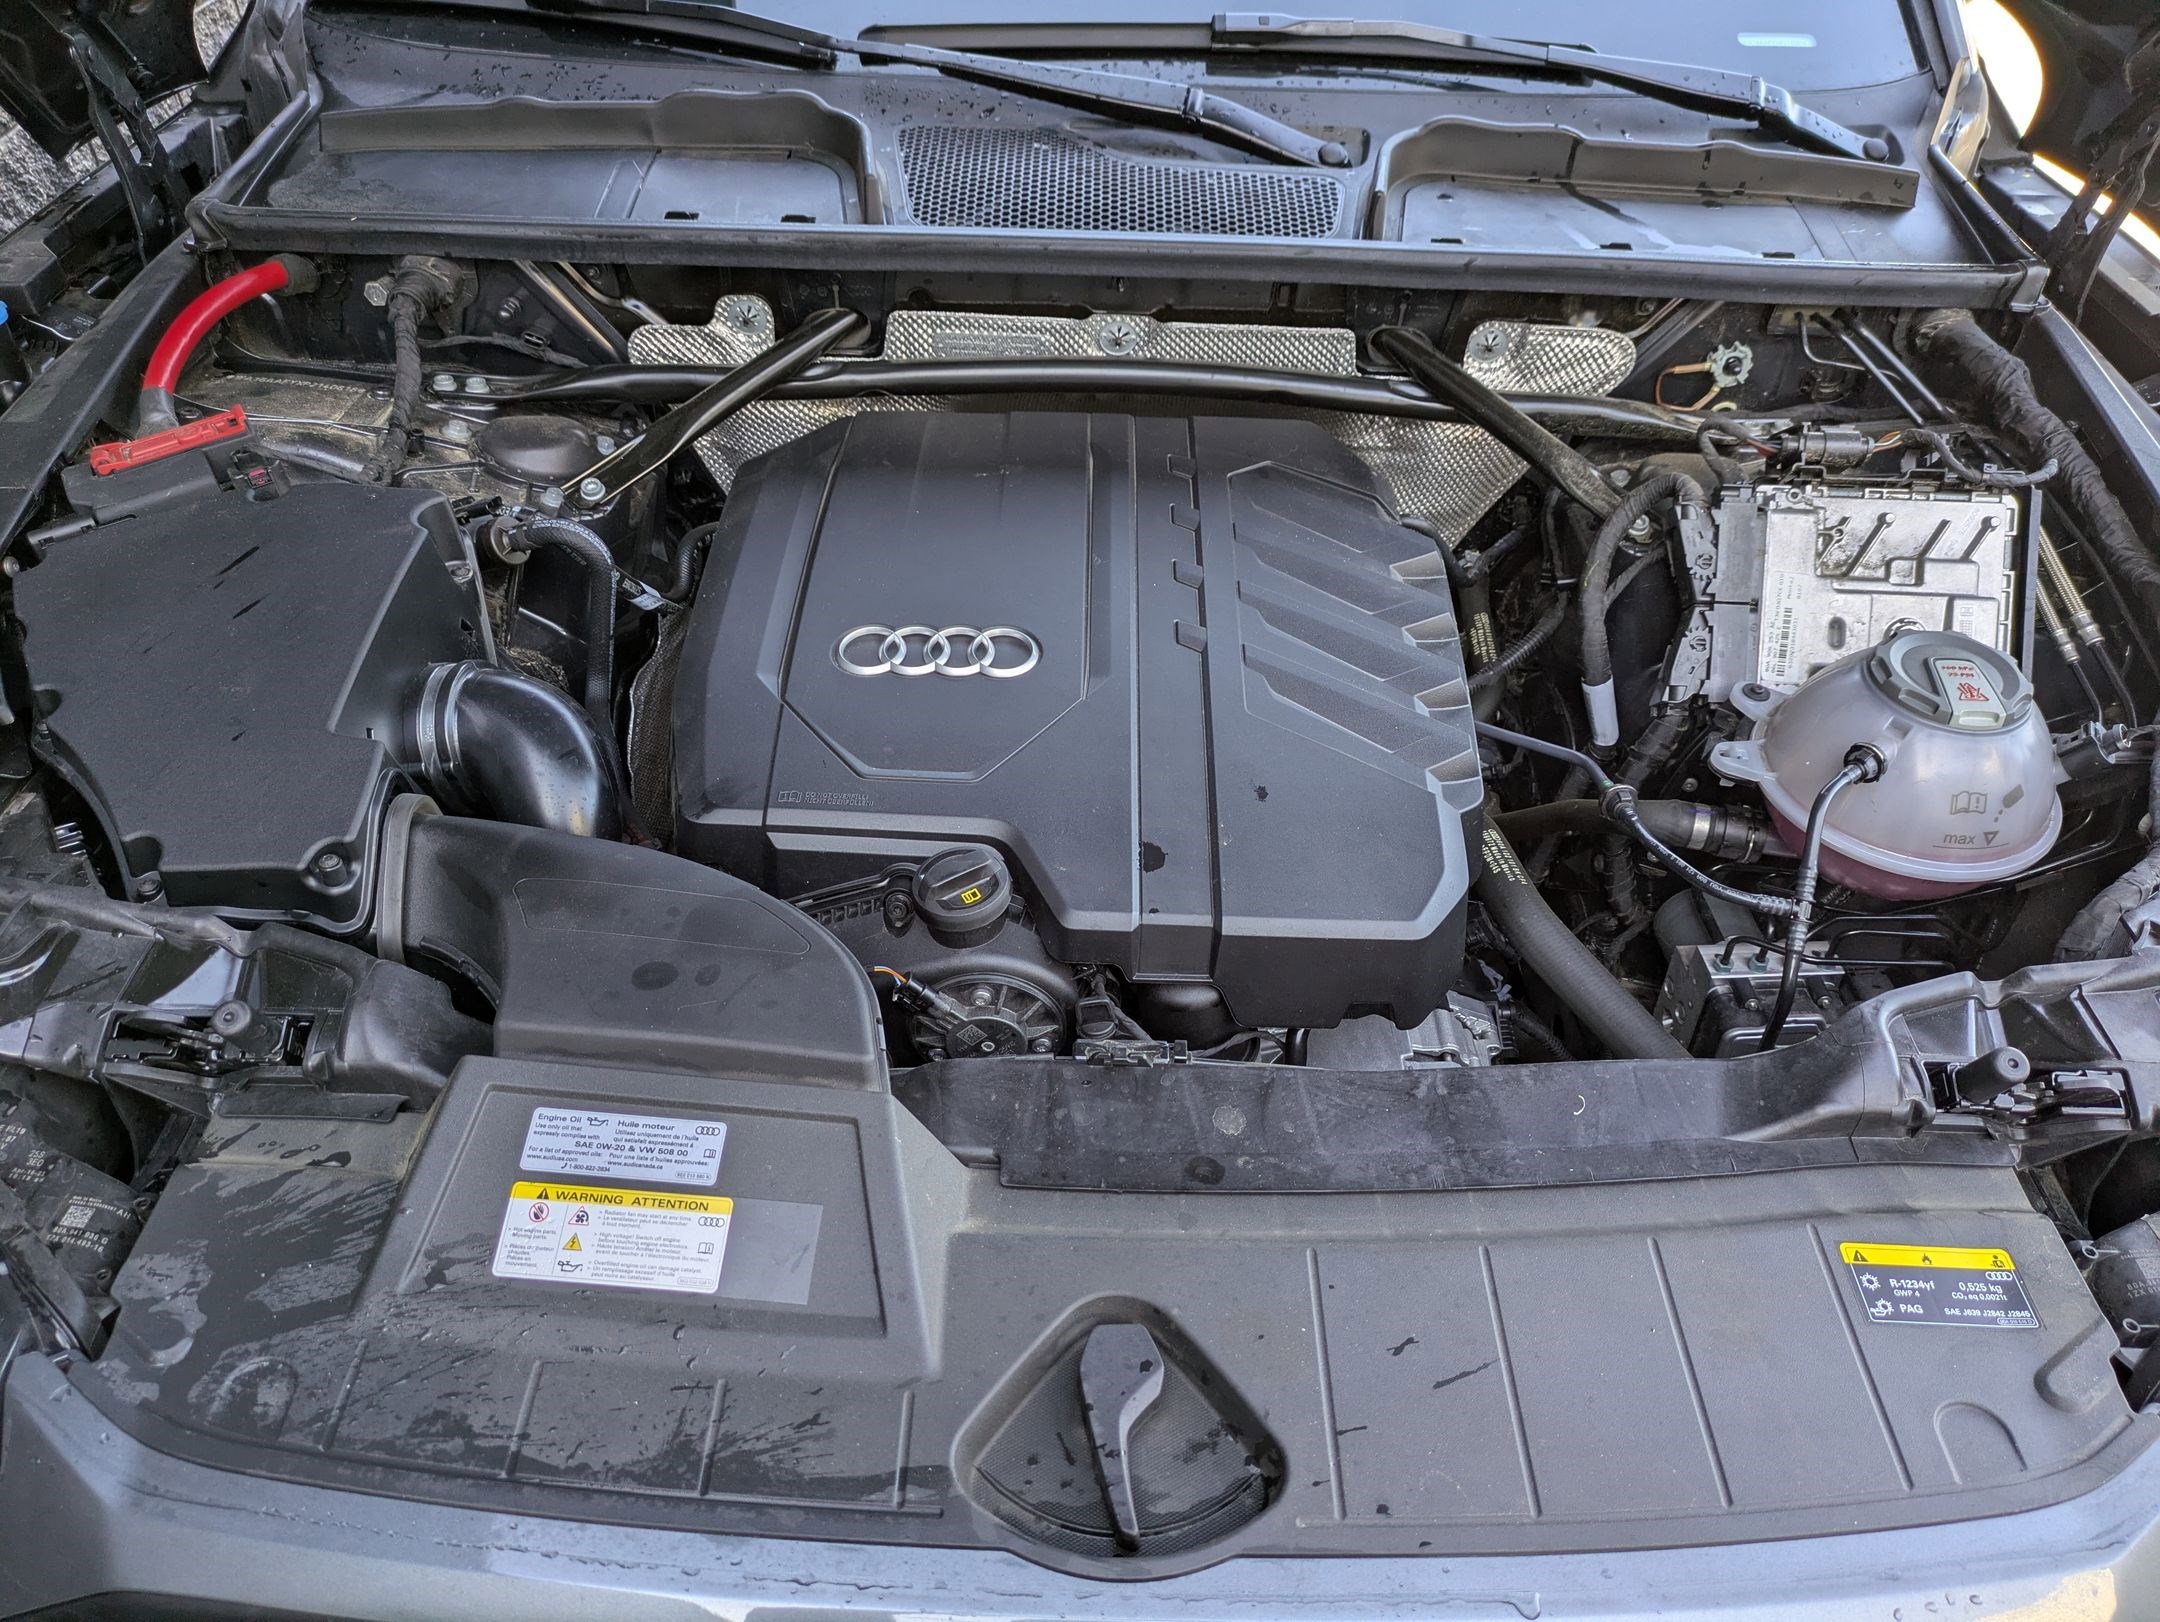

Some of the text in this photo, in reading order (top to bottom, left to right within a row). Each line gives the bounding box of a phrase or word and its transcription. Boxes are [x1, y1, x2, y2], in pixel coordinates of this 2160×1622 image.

[1943, 834, 1976, 844] max
[538, 1114, 567, 1122] Engine
[618, 1120, 675, 1131] Huile moteur
[596, 1142, 625, 1151] 0W-20
[639, 1146, 656, 1154] VW
[527, 1154, 578, 1162] www.audiusa.com
[607, 1161, 663, 1170] www.audicanada.ca
[556, 1191, 709, 1211] WARNING ATTENTION
[1889, 1279, 1935, 1291] R-1234yf
[1959, 1282, 2002, 1293] 0,525 kg
[1900, 1304, 1923, 1313] PAG
